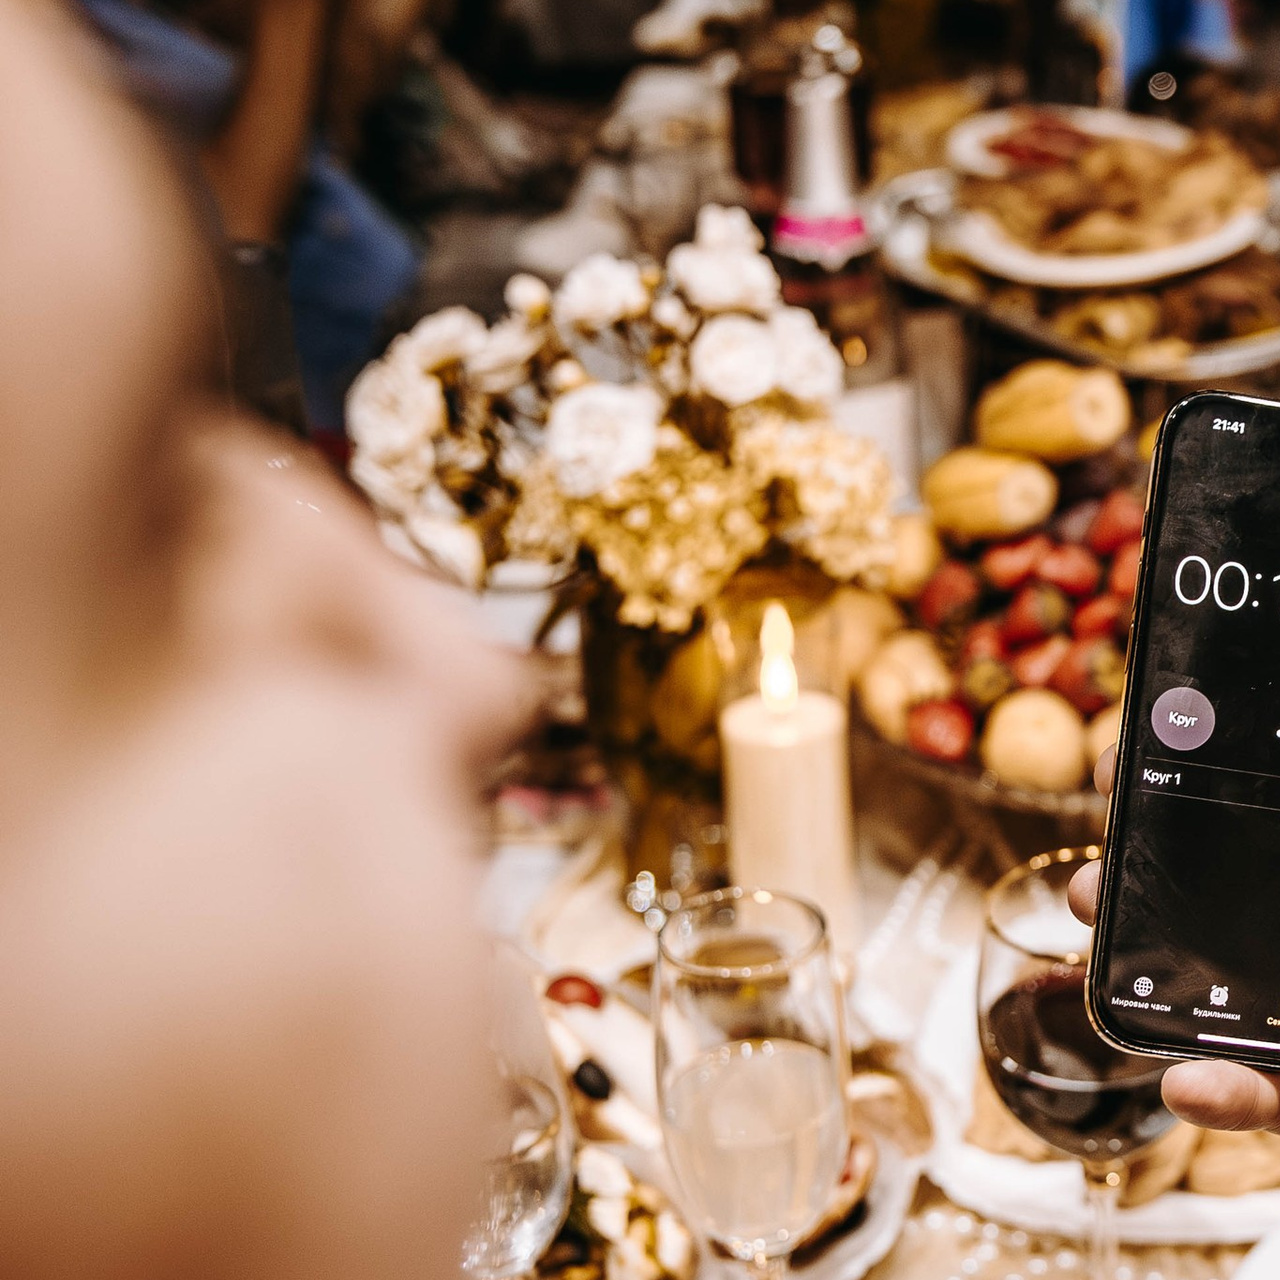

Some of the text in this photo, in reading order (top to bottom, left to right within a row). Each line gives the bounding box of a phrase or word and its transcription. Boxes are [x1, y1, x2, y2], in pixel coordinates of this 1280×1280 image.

[1212, 418, 1246, 434] 21:41
[1168, 711, 1198, 728] Круг
[1142, 768, 1181, 786] Круг 1
[1111, 996, 1172, 1012] Мировые часы
[1192, 1007, 1241, 1021] Будильники
